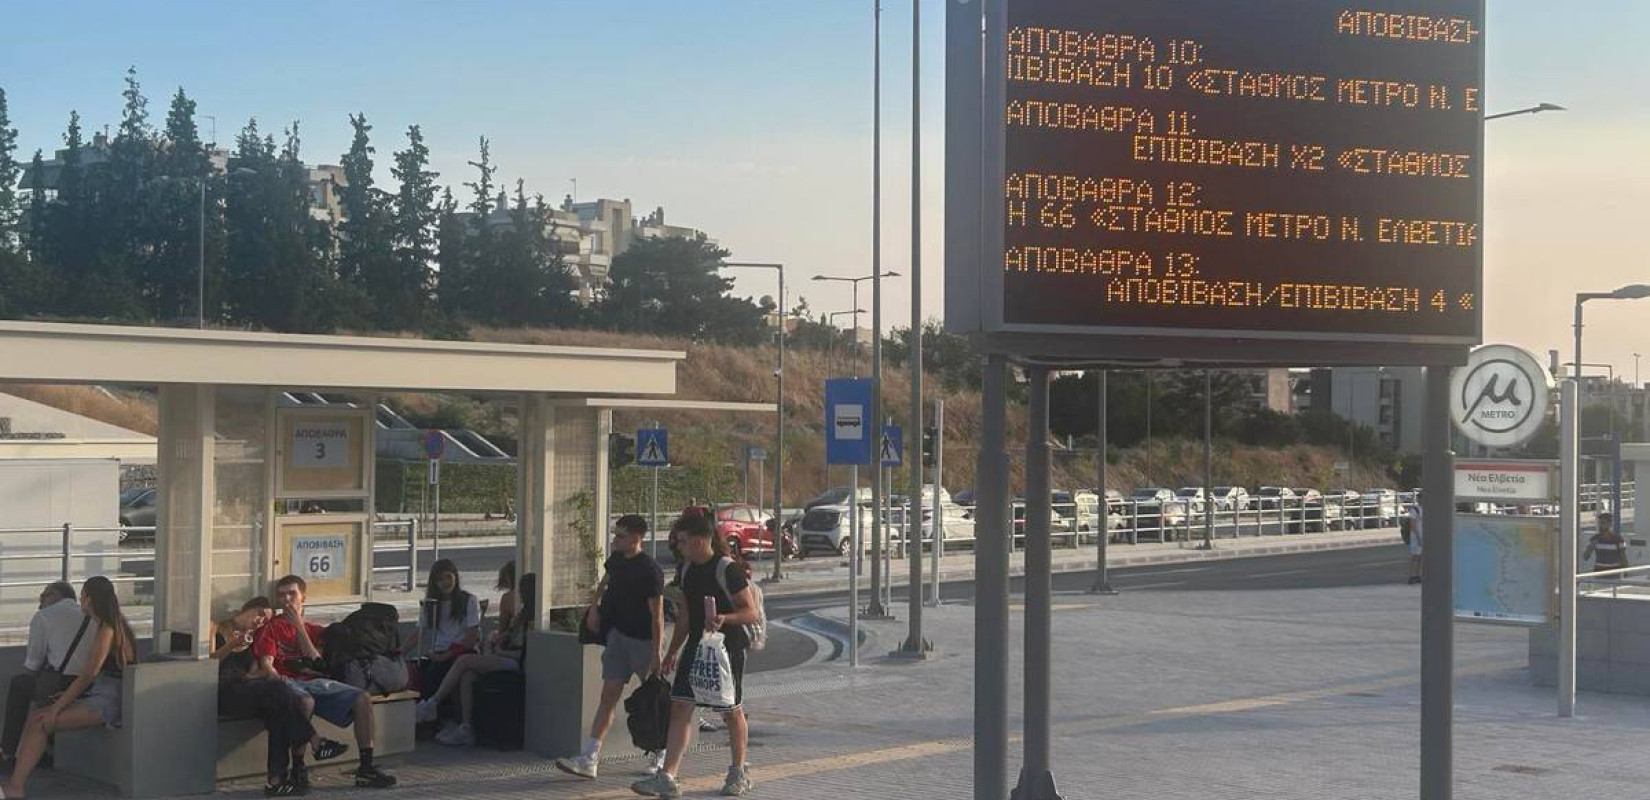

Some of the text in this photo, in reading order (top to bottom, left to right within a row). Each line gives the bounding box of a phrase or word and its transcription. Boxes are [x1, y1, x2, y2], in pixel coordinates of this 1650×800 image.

[1008, 26, 1203, 65] ΑΠΟΒΑΘΡΑ 10:
[1008, 54, 1130, 88] ΙΒΙΒΑΣΗ
[1144, 65, 1173, 89] 10
[1338, 78, 1419, 107] ΜΕΤΡΟ
[1430, 85, 1452, 109] Ν.
[1007, 100, 1197, 136] ΑΠΟΒΑΘΡΑ 11:
[1133, 135, 1279, 167] ΕΠΙΒΙΒΑΣΗ
[1006, 172, 1201, 207] ΑΠΟΒΑΘΡΑ 12:
[1008, 200, 1026, 226] Η
[1040, 202, 1076, 228] 66
[1246, 212, 1330, 240] ΜΕΤΡΟ
[1341, 216, 1364, 241] Ν.
[1005, 246, 1200, 278] ΑΠΟΒΑΘΡΑ 13:
[1430, 289, 1447, 313] 4
[1480, 410, 1516, 419] METRO
[314, 442, 326, 460] 3
[296, 539, 344, 550] ΑΠΟΒΙΒΑΣΗ
[310, 556, 331, 573] 66
